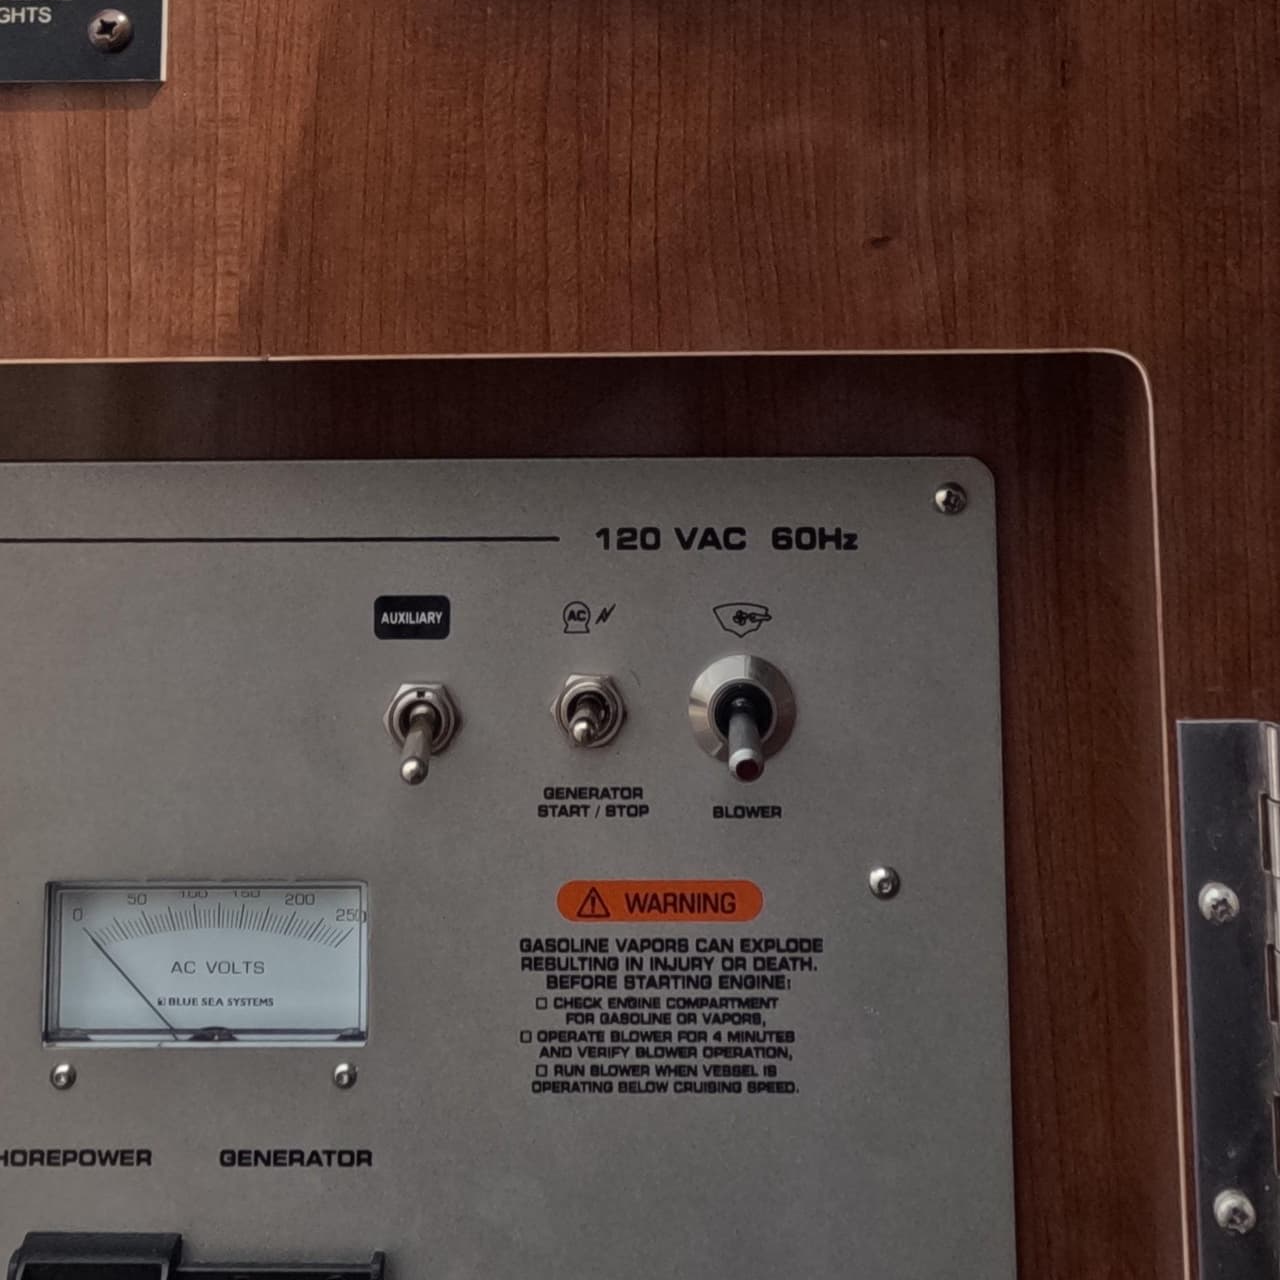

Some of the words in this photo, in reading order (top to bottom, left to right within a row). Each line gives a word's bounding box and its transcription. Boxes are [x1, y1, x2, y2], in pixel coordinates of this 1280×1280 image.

[595, 526, 661, 551] 120
[673, 526, 747, 551] VAC
[771, 526, 859, 551] 60Hz
[380, 611, 443, 625] AUXILIARY
[543, 786, 644, 801] GENERATOR
[537, 804, 591, 818] START
[605, 803, 650, 818] STOP
[712, 805, 782, 820] BLOWER
[126, 892, 148, 906] 50
[284, 892, 316, 907] 200
[624, 891, 737, 915] WARNING
[72, 907, 84, 922] 0
[519, 937, 609, 954] GASOLINE
[615, 937, 690, 954] VAPORS
[695, 937, 734, 954] CAN
[739, 937, 824, 954] EXPLODE
[170, 960, 196, 975] AC
[205, 960, 265, 975] VOLTS
[520, 956, 620, 972] RESULTING
[625, 956, 644, 972] IN
[649, 956, 715, 972] INJURY
[721, 956, 747, 972] OR
[546, 974, 618, 990] BEFORE
[623, 974, 713, 991] STARTING
[168, 997, 199, 1007] BLUE
[201, 997, 224, 1007] SEA
[227, 997, 274, 1007] SYSTEMS
[553, 996, 603, 1010] CHECK
[607, 996, 661, 1010] ENGINE
[665, 996, 780, 1010] COMPARTMENT
[565, 1011, 595, 1025] FOR
[599, 1011, 672, 1026] GASOLINE
[676, 1012, 698, 1025] OR
[536, 1029, 605, 1043] OPERATE
[610, 1029, 673, 1043] BLOWER
[677, 1030, 708, 1044] FOR
[712, 1030, 722, 1043] 4
[727, 1030, 796, 1044] MINUTES
[538, 1045, 573, 1059] AND
[576, 1045, 631, 1059] VERIFY
[635, 1045, 698, 1059] BLOWER
[553, 1063, 586, 1078] RUN
[589, 1063, 651, 1078] BLOWER
[654, 1064, 699, 1078] WHEN
[702, 1063, 759, 1078] VESSEL
[762, 1064, 778, 1078] IS
[531, 1080, 614, 1094] OPERATING
[617, 1080, 669, 1094] BELOW
[673, 1080, 743, 1094] CRUISING
[219, 1149, 373, 1168] GENERATOR
